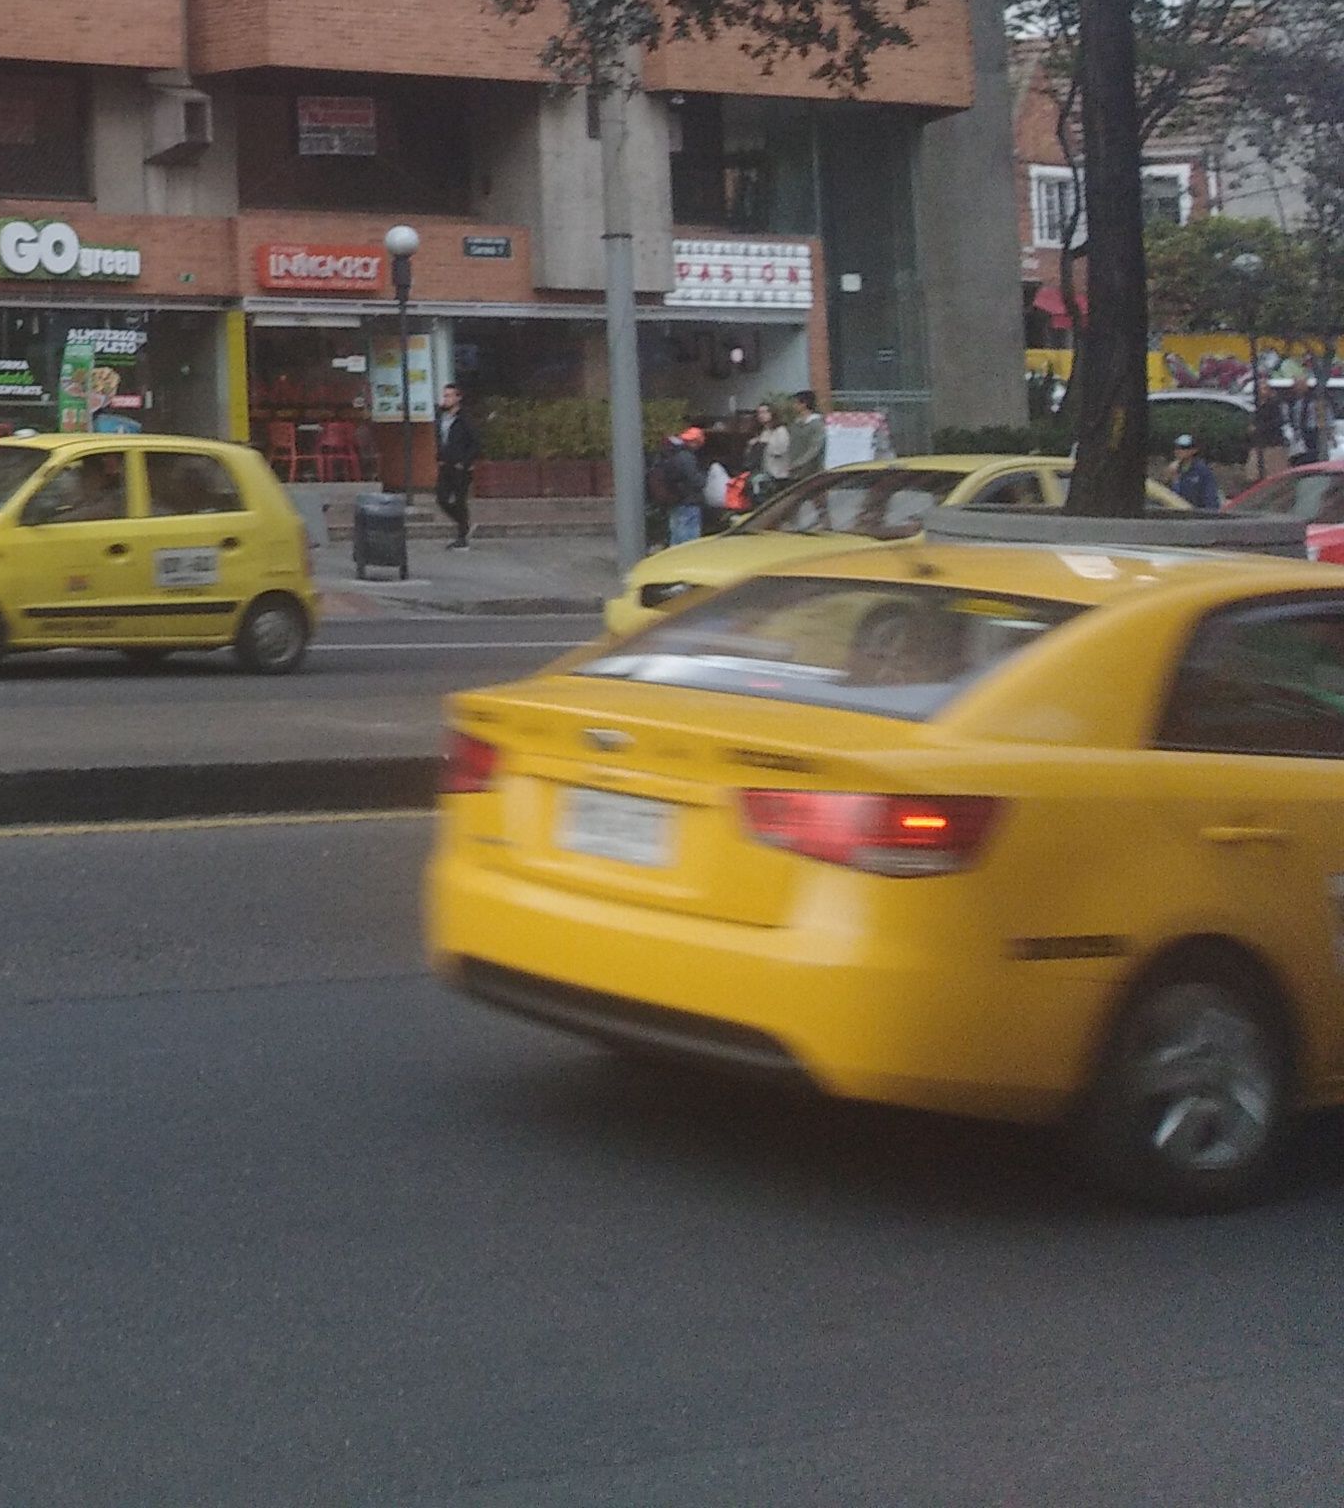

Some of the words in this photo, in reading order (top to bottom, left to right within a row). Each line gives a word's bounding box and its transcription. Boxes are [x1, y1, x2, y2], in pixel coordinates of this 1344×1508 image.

[0, 221, 80, 274] GO
[79, 248, 141, 277] green
[67, 328, 137, 341] ALMUERZO
